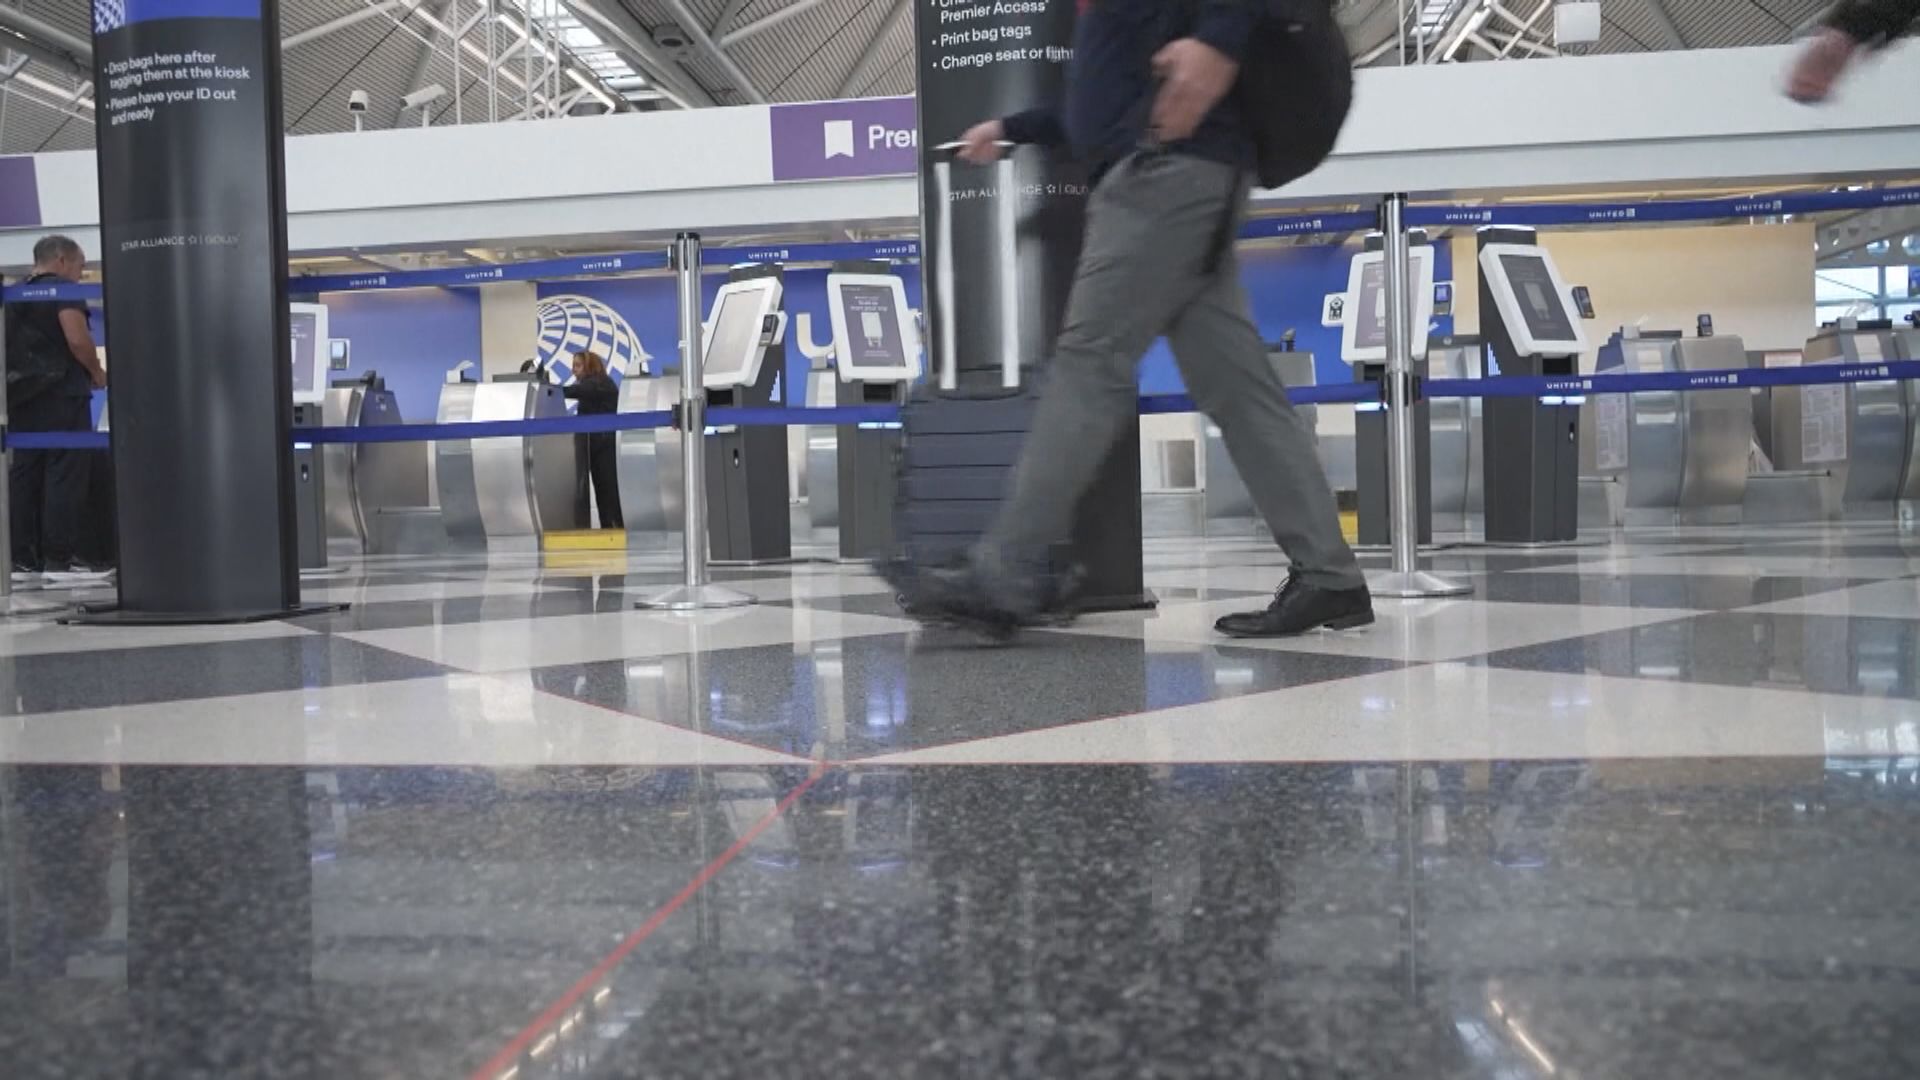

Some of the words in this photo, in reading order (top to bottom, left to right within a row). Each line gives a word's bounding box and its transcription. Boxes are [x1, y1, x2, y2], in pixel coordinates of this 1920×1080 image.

[940, 4, 991, 24] Premier
[941, 33, 970, 47] Print
[972, 28, 998, 41] bag
[1000, 25, 1032, 39] tags
[108, 61, 128, 75] Drop
[129, 56, 153, 69] bags
[154, 52, 182, 65] here
[184, 50, 216, 63] after
[941, 52, 993, 69] Change
[996, 49, 1026, 61] seat
[1029, 48, 1043, 59] or
[109, 73, 142, 89] tagging
[143, 68, 173, 81] them
[174, 67, 188, 79] at
[190, 66, 212, 78] the
[214, 65, 250, 79] kiosk
[110, 95, 137, 110] Please
[138, 91, 165, 104] have
[166, 89, 195, 104] your
[196, 87, 211, 100] ID
[213, 89, 237, 100] out
[111, 110, 127, 125] and
[127, 106, 155, 120] ready
[1446, 212, 1481, 221] UNITED
[1589, 209, 1625, 218] UNITED
[1277, 222, 1312, 231] UNITED
[140, 235, 185, 248] ALLIANCE
[875, 246, 908, 254] UNITED
[748, 252, 780, 260] UNITED
[582, 261, 612, 270] UNITED
[464, 271, 494, 280] UNITED
[1840, 367, 1878, 377] UNITED
[1690, 375, 1727, 384] UNITED
[1546, 381, 1582, 390] UNITED
